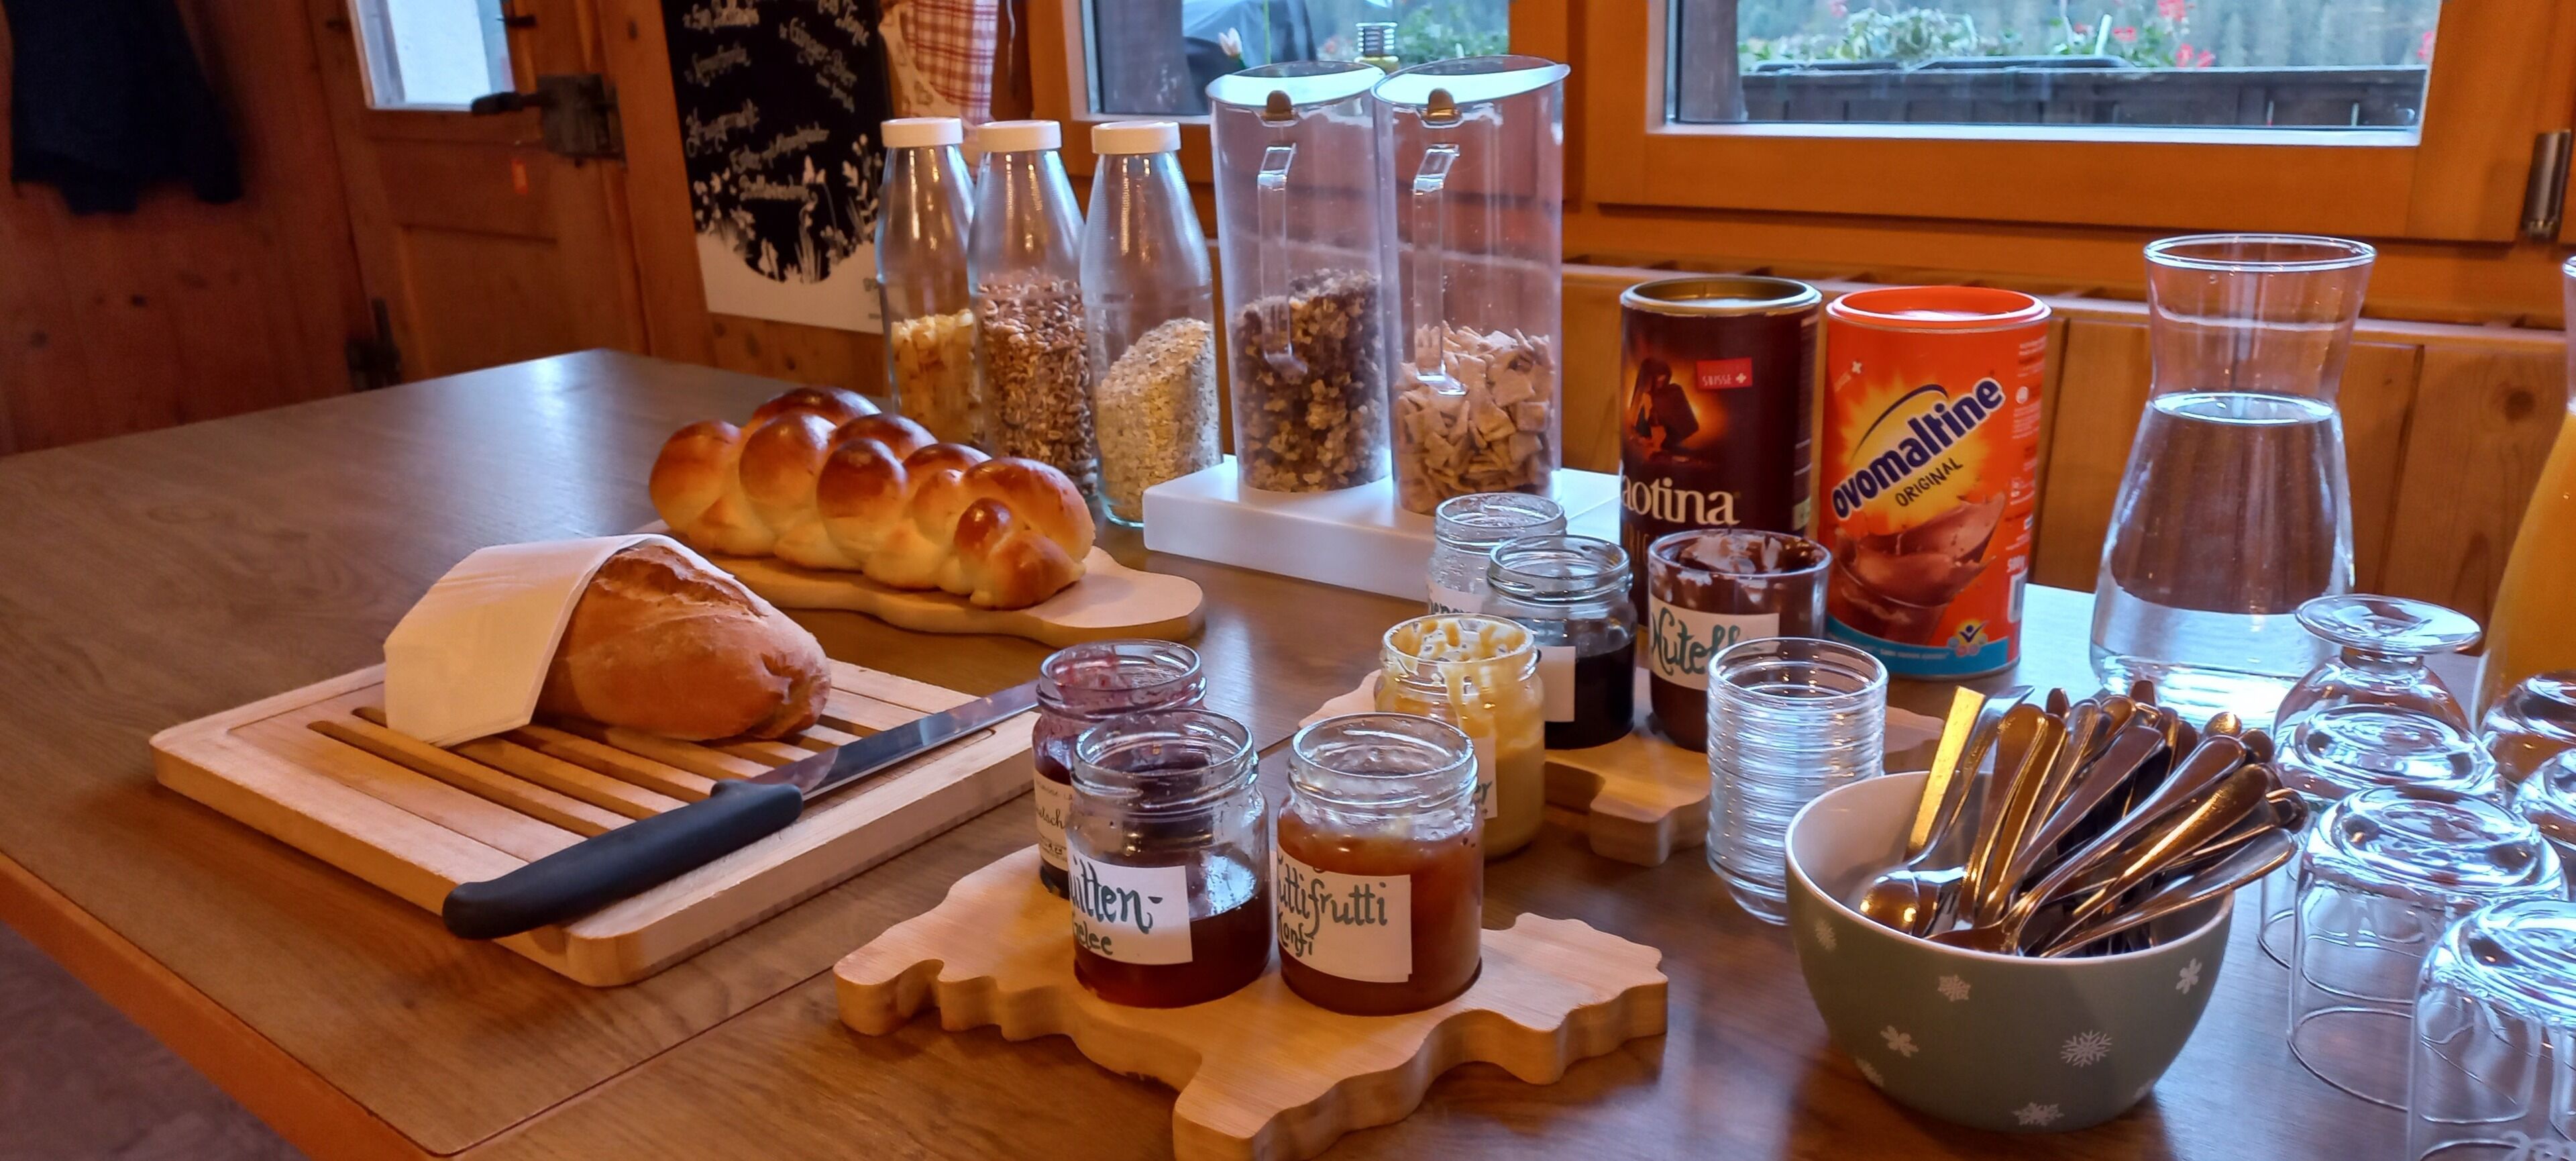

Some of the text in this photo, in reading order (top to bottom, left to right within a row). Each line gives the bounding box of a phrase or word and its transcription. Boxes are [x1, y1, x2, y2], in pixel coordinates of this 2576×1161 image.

[1832, 378, 2005, 520] ovomaltine
[1895, 458, 1964, 507] ORIGINAL
[1621, 474, 1741, 525] aotina
[1067, 854, 1163, 935] uitten-
[1277, 855, 1388, 938] uttifrutti
